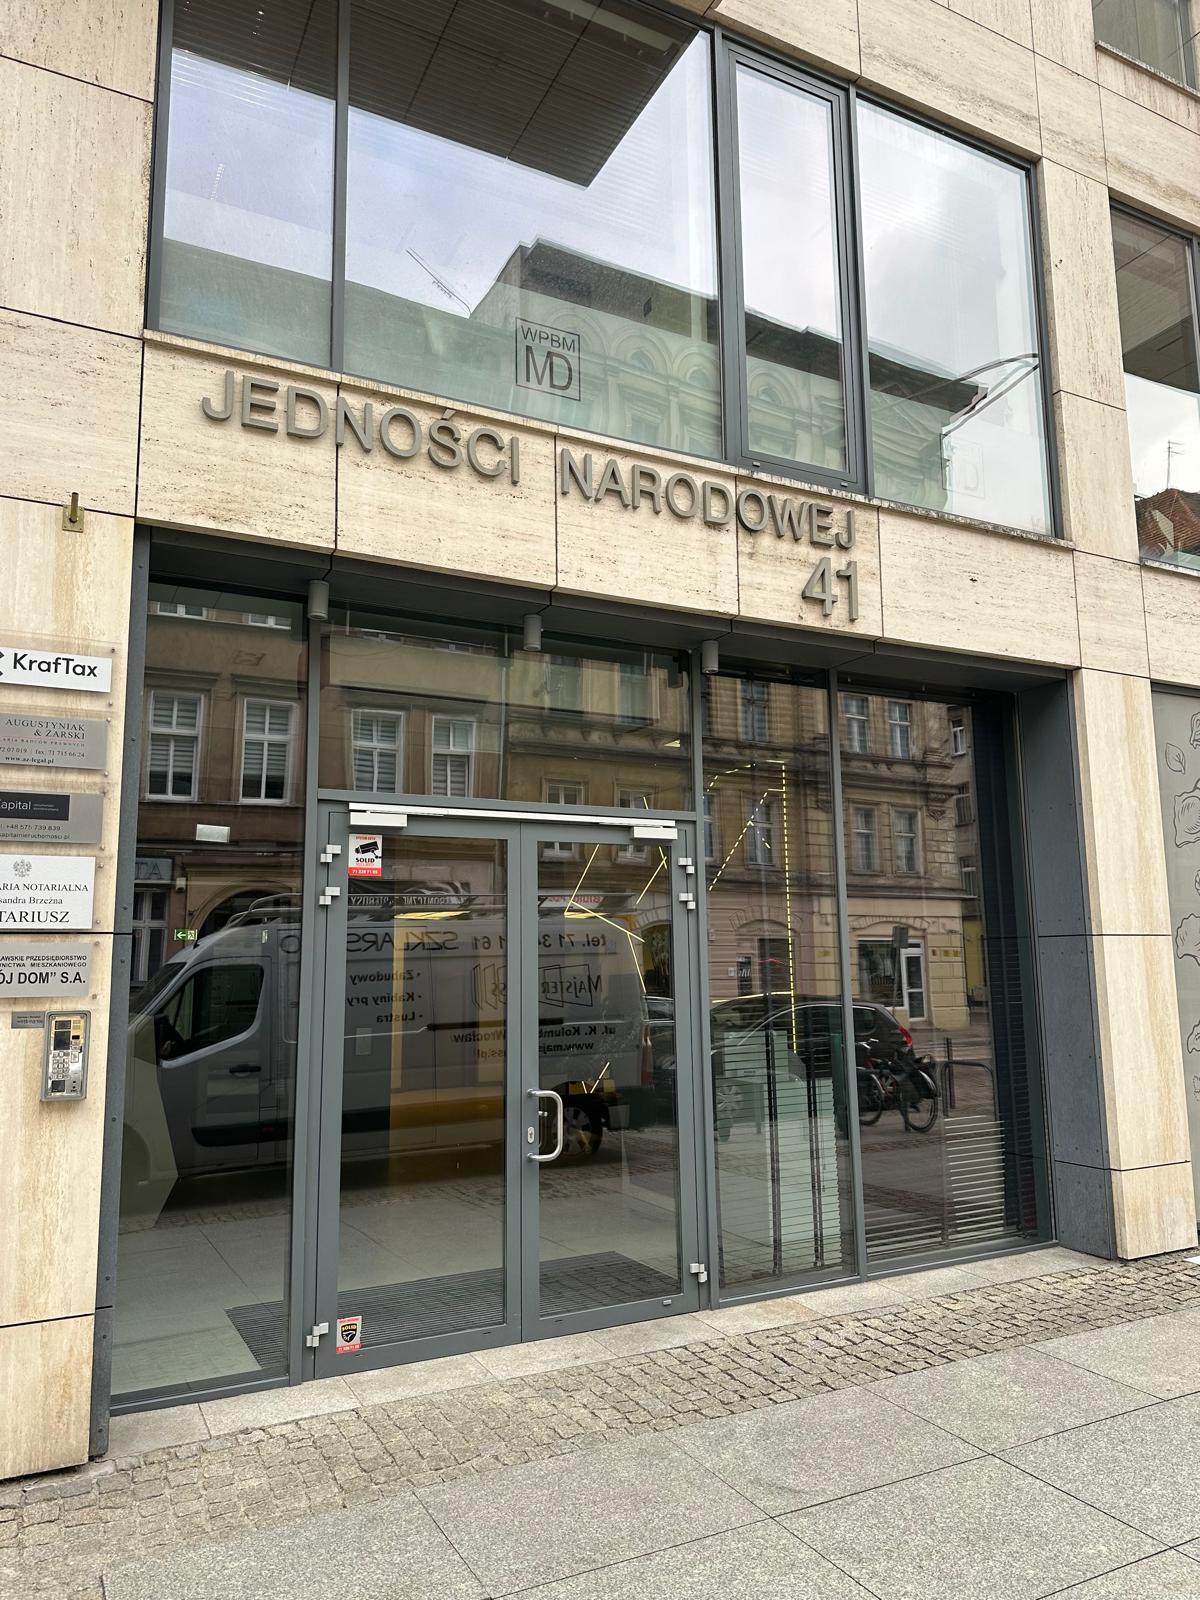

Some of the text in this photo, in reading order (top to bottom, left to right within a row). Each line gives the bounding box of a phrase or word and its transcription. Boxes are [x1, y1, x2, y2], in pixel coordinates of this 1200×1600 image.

[521, 324, 576, 353] WPBM
[525, 344, 573, 391] MD
[202, 370, 856, 550] JEDNOŚCI NARODOWEJ
[802, 556, 858, 622] 41
[13, 652, 98, 678] KrafTax
[5, 719, 85, 732] AUGUSTYNIAK
[33, 729, 42, 737] &
[0, 800, 31, 811] apital
[0, 883, 88, 892] RIA NOTARIALNA
[61, 971, 86, 984] S.A.
